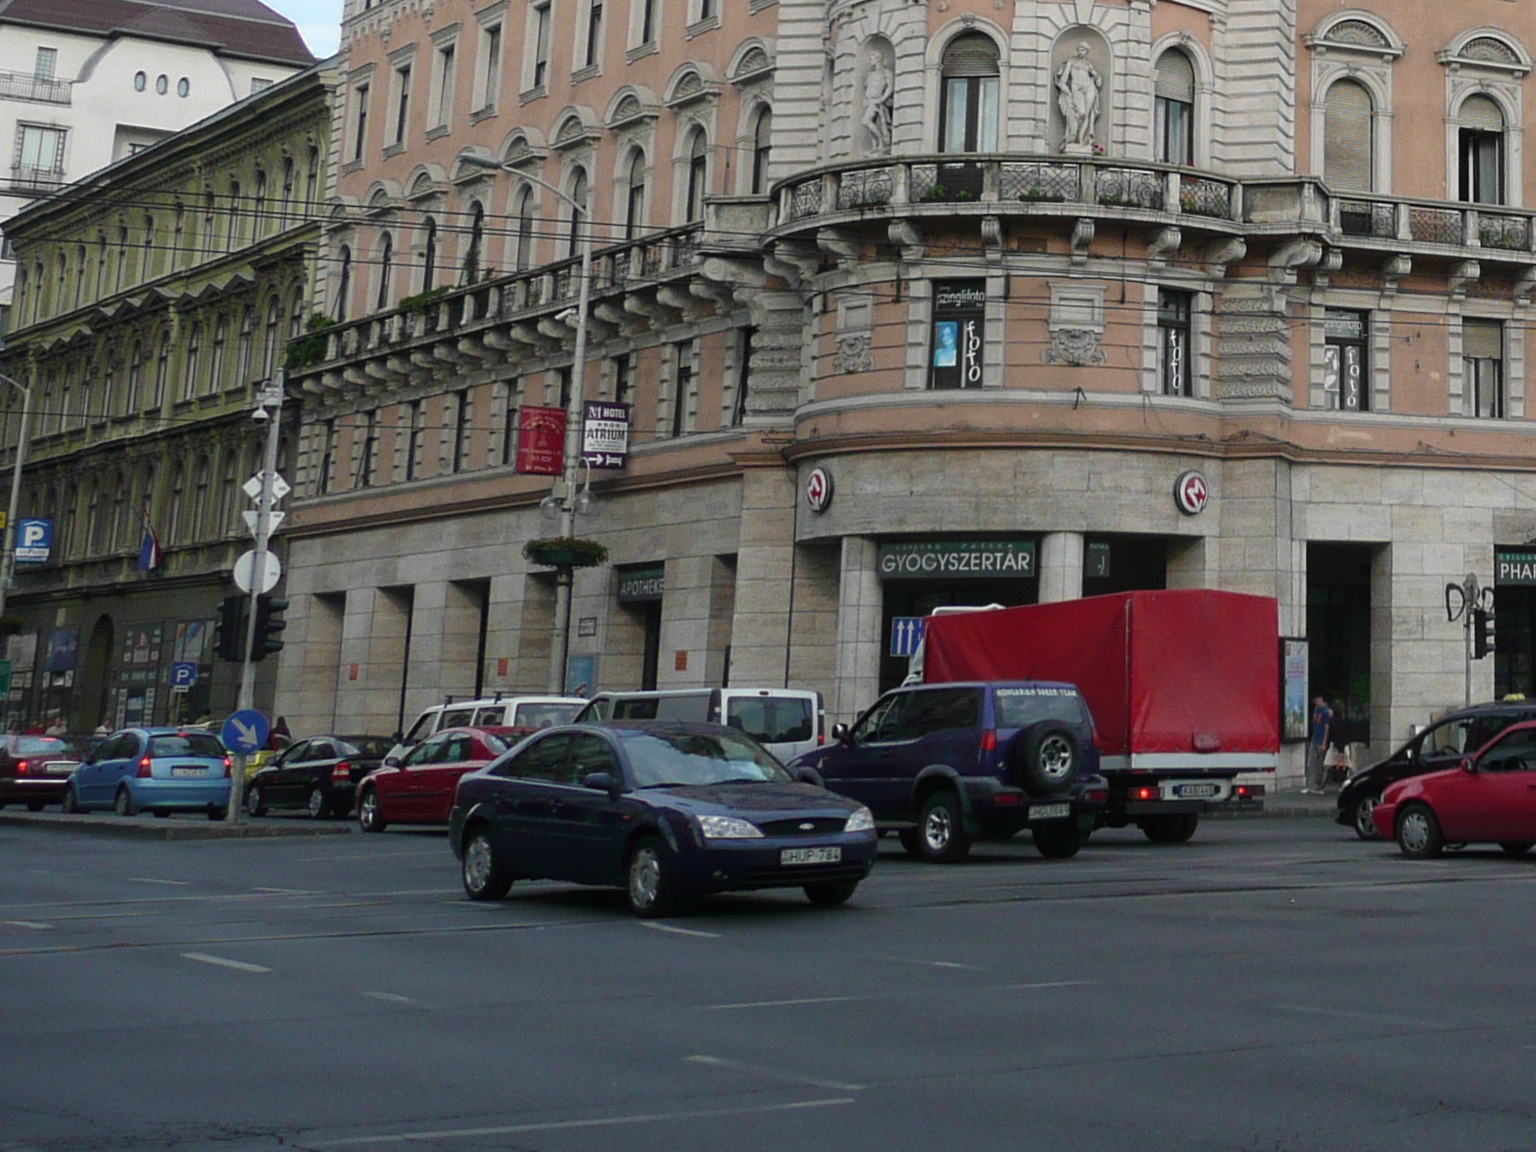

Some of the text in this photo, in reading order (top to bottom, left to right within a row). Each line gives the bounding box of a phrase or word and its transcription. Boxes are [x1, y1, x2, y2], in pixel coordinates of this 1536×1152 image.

[603, 407, 626, 419] HOTEL
[586, 427, 625, 441] ATRIUM
[23, 525, 45, 546] P
[882, 548, 1030, 573] GYÓGYSZERTÁR
[621, 577, 664, 596] APOTHEKE
[176, 669, 189, 682] P
